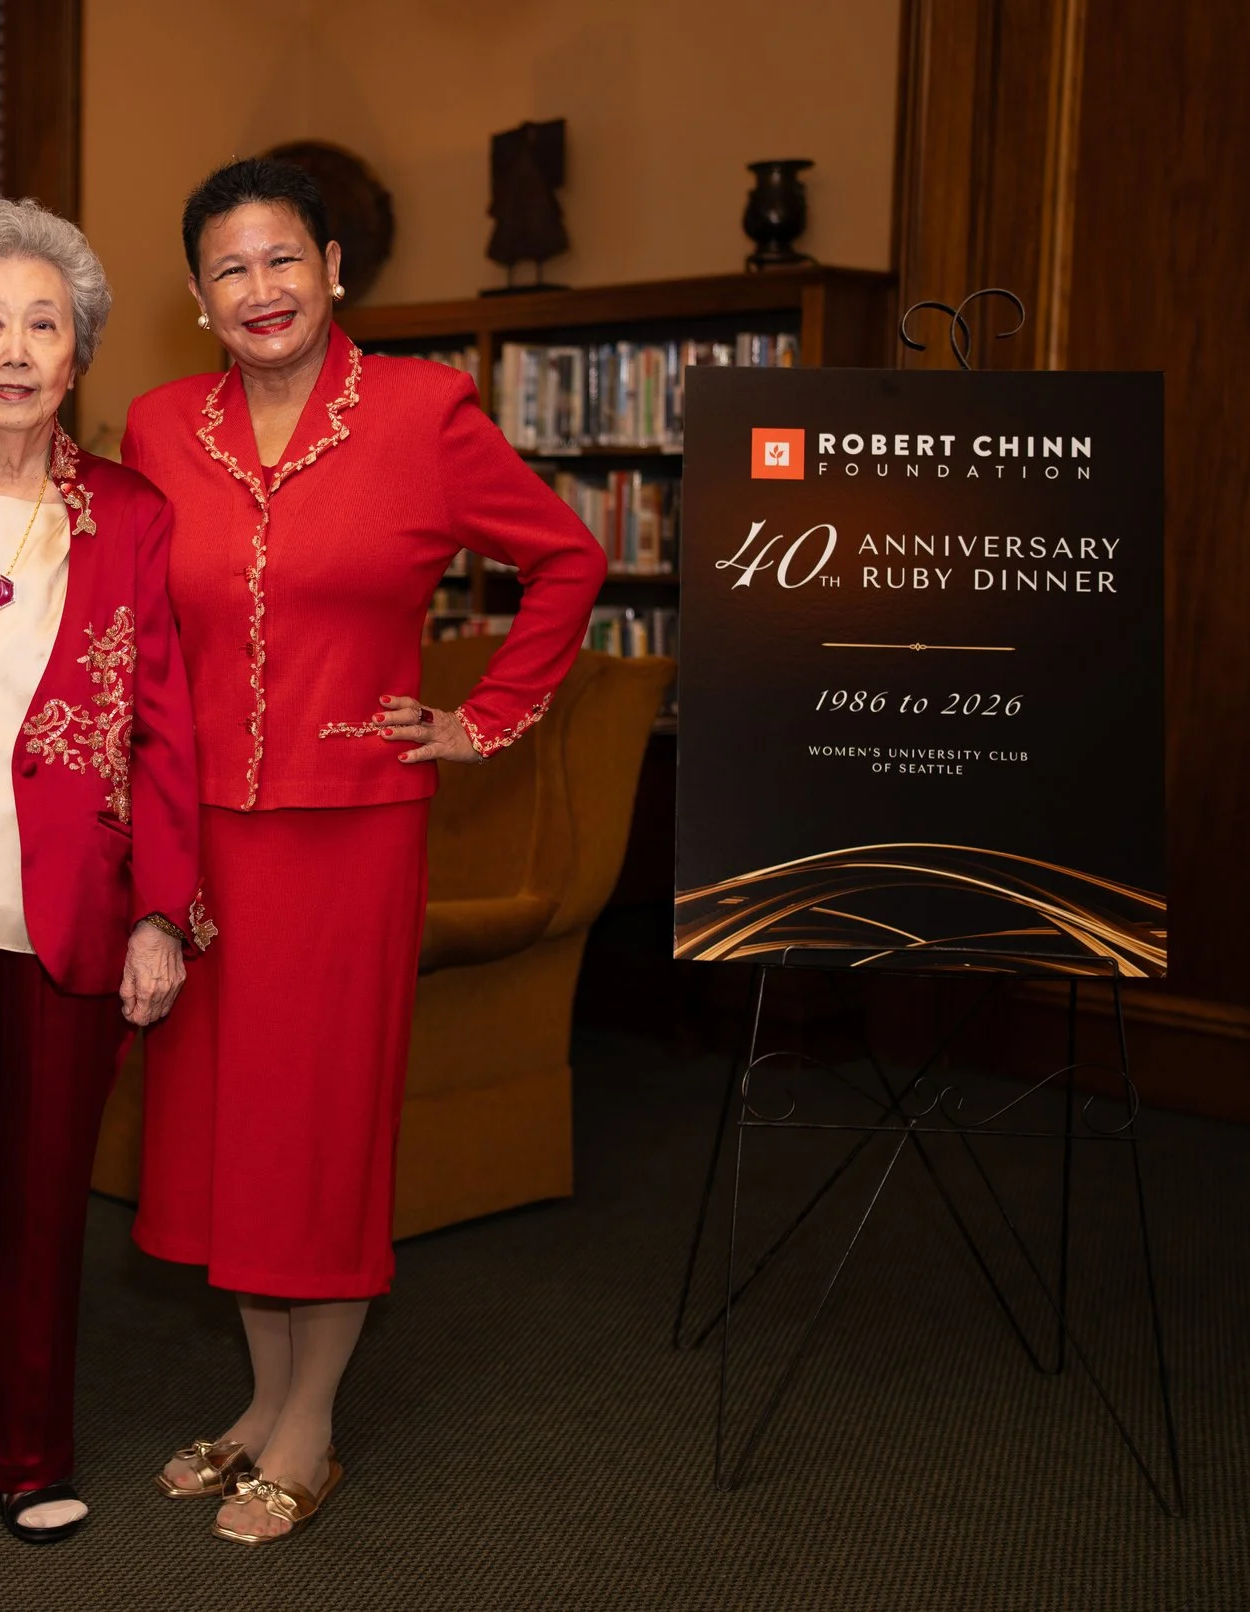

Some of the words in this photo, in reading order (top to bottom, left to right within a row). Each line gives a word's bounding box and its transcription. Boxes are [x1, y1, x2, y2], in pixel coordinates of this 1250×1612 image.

[818, 433, 956, 456] ROBERT
[972, 435, 1092, 459] CHINN
[818, 463, 1091, 480] FOUNDATION
[858, 533, 1121, 561] ANNIVERSARY
[862, 566, 953, 590] RUBY
[973, 569, 1117, 594] DINNER
[814, 688, 888, 713] 1986
[898, 693, 929, 714] to
[940, 693, 1025, 717] 2026
[808, 745, 881, 759] WOMEN'S
[888, 747, 982, 761] UNIVERSITY
[988, 751, 1029, 762] CLUB
[871, 763, 892, 774] OF
[898, 764, 964, 775] SEATTLE
